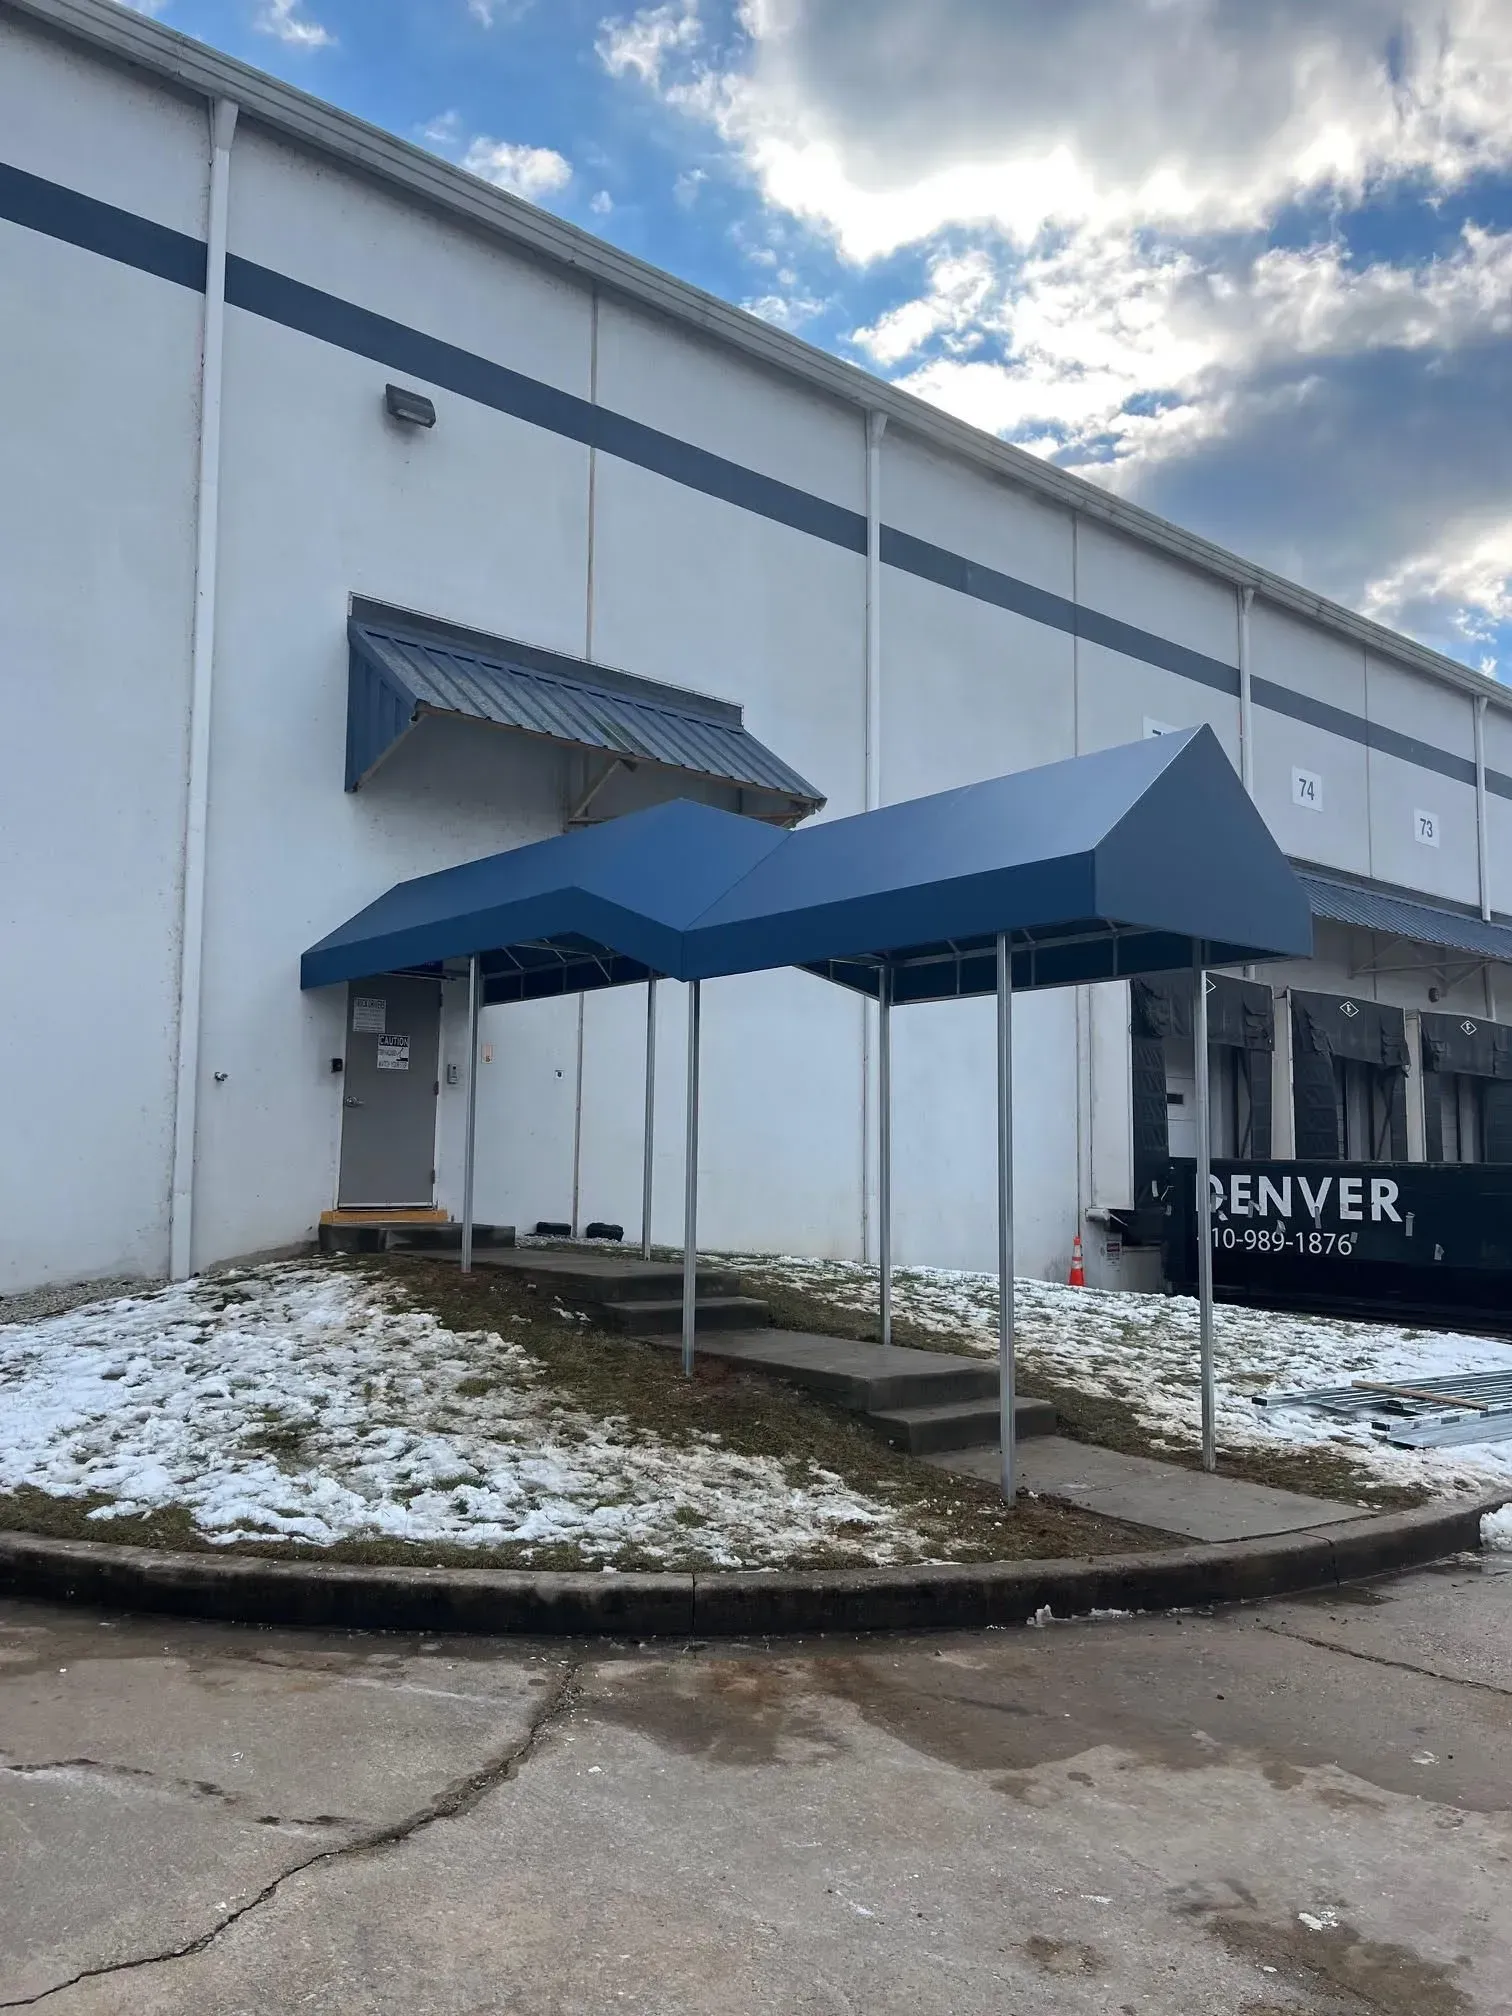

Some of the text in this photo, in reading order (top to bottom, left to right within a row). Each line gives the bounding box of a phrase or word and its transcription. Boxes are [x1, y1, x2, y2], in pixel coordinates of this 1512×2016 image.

[1298, 777, 1315, 801] 74
[1419, 817, 1433, 838] 73
[379, 1035, 408, 1047] CAUTION
[1197, 1227, 1353, 1256] 10-989-1876
